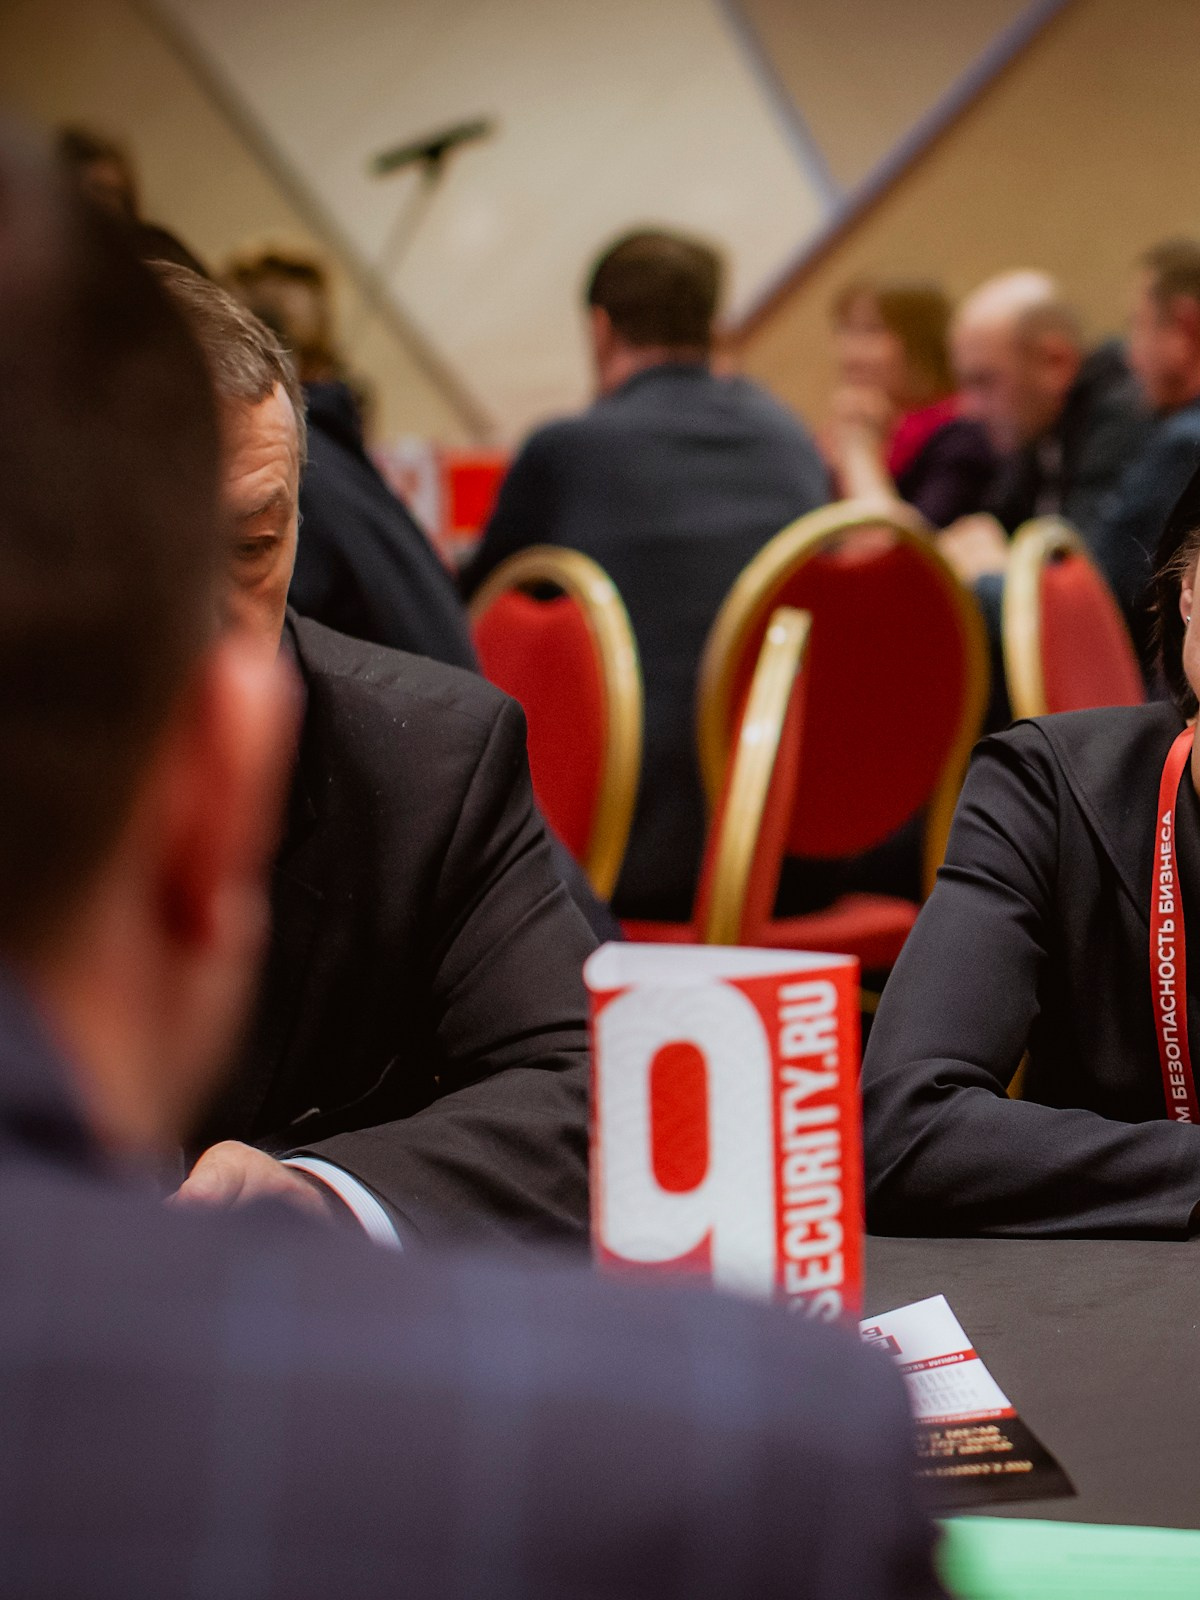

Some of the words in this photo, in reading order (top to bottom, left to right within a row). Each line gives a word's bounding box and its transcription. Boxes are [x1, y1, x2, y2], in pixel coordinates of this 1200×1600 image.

[1158, 809, 1176, 914] БИЗНЕСА
[1157, 918, 1188, 1100] БЕЗОПАСНОСТЬ
[777, 979, 845, 1322] SECURITY.RU
